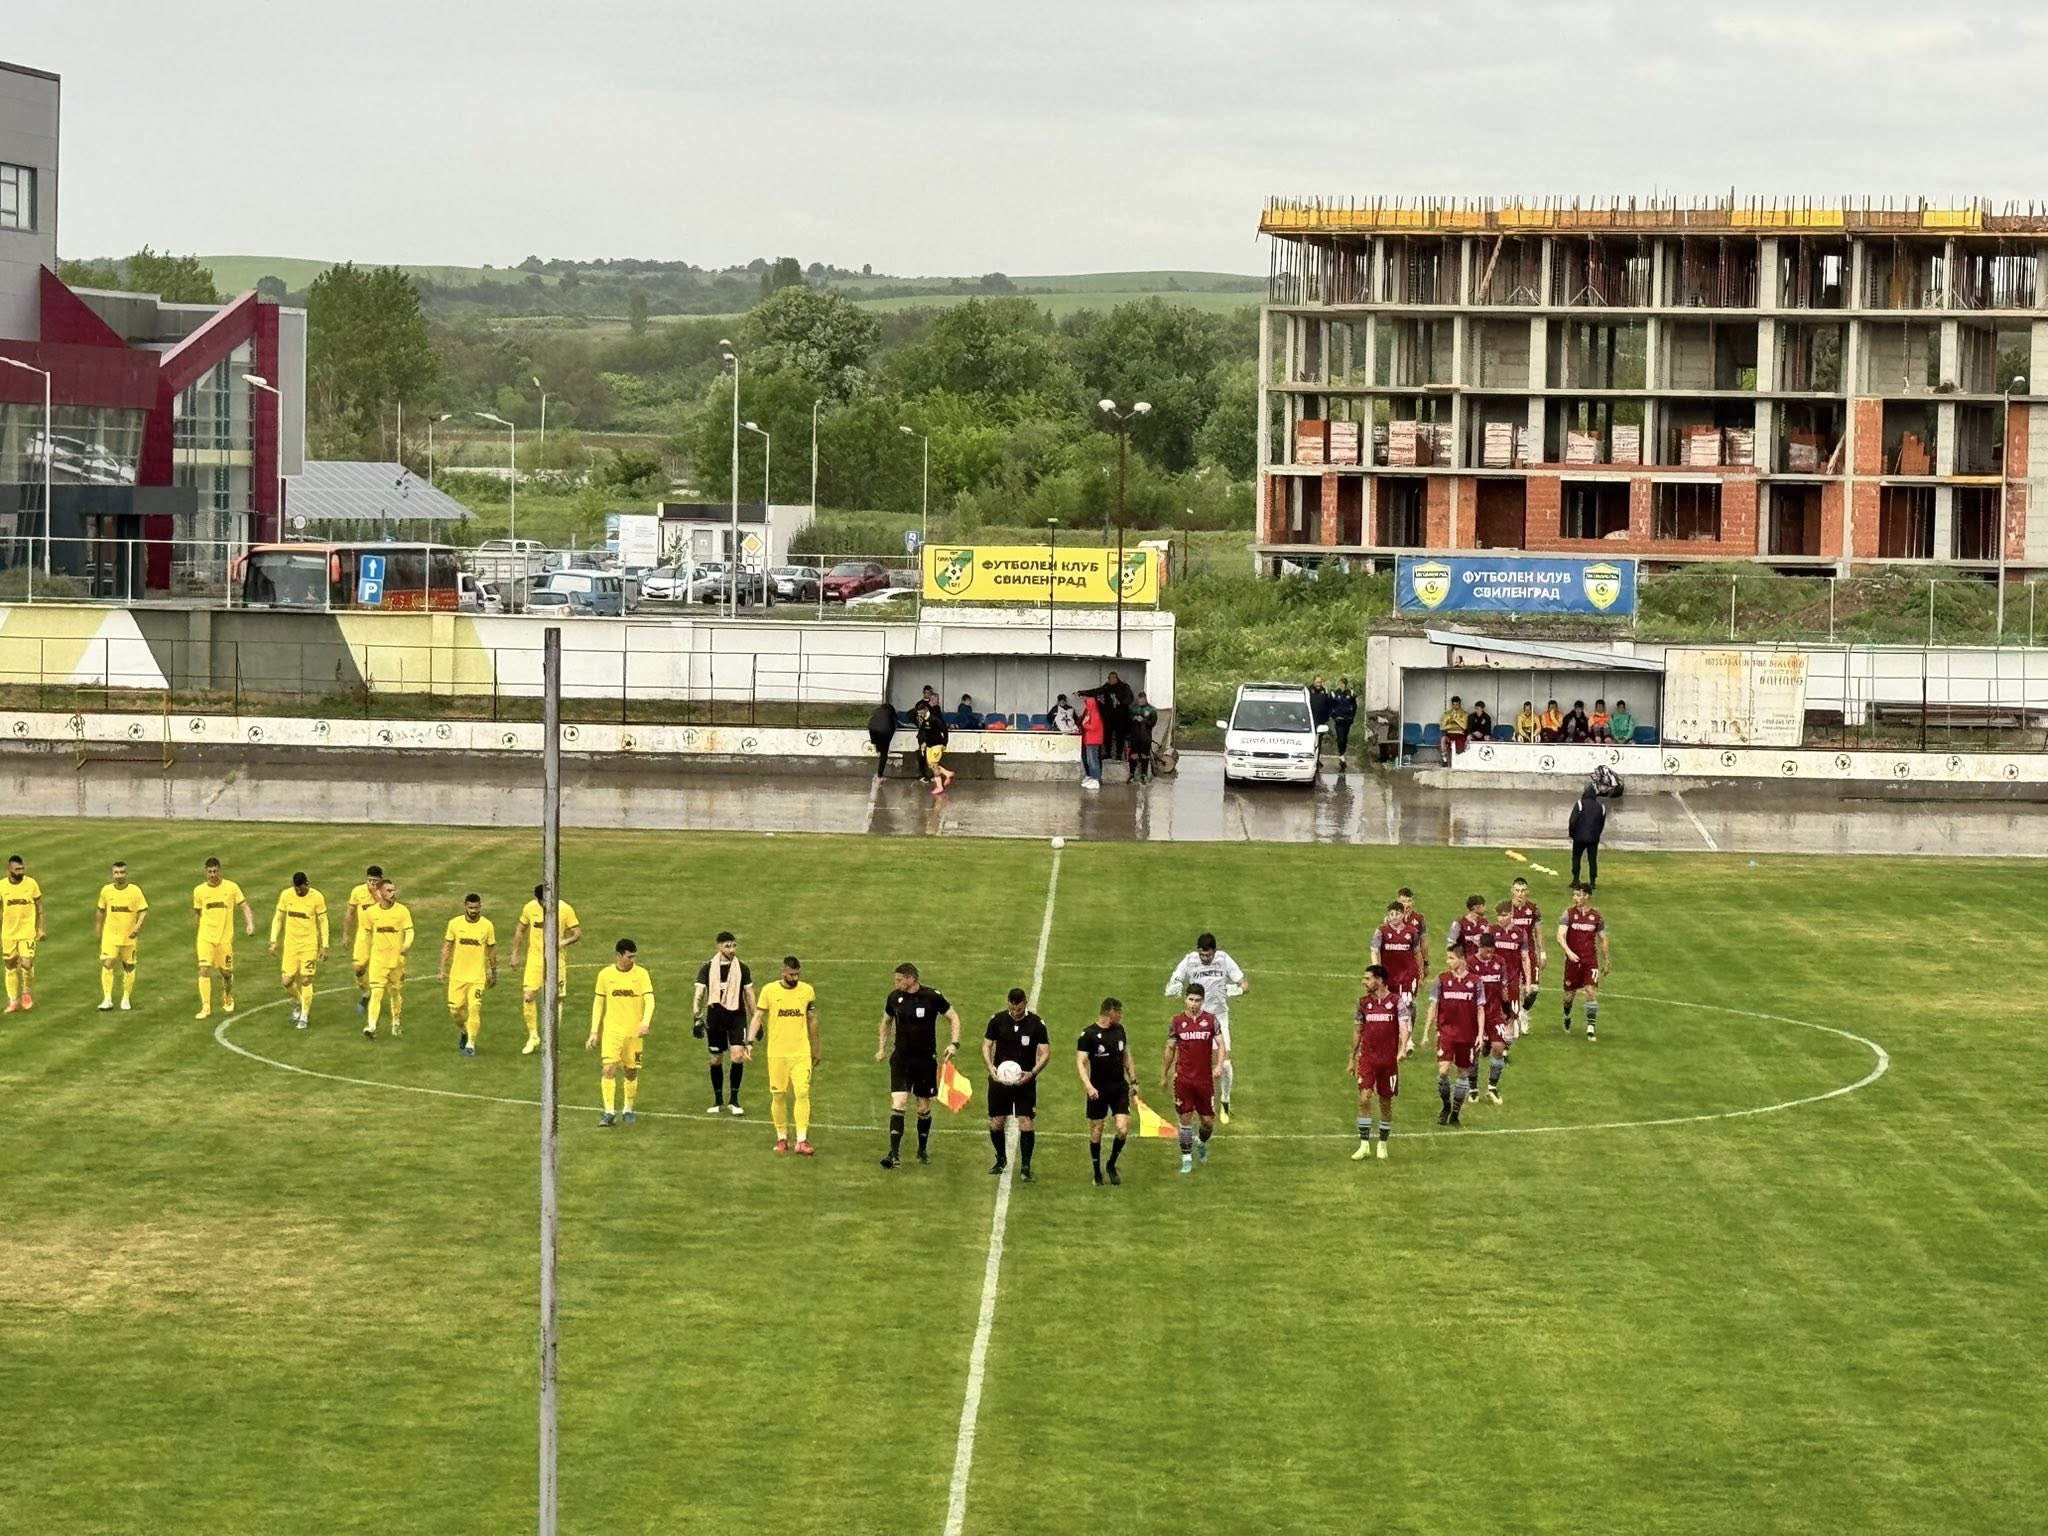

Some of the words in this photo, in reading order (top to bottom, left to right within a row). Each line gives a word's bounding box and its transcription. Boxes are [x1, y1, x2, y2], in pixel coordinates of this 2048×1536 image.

[982, 560, 1058, 571] ФУТБОЛЕН
[1062, 561, 1099, 572] КЛУБ
[993, 575, 1087, 588] СВИЛЕНГРАД
[1462, 570, 1533, 584] ФУТБОЛЕН
[1537, 571, 1572, 584] КЛУБ
[364, 582, 378, 600] P
[1473, 587, 1560, 600] СВИЛЕНГРАД
